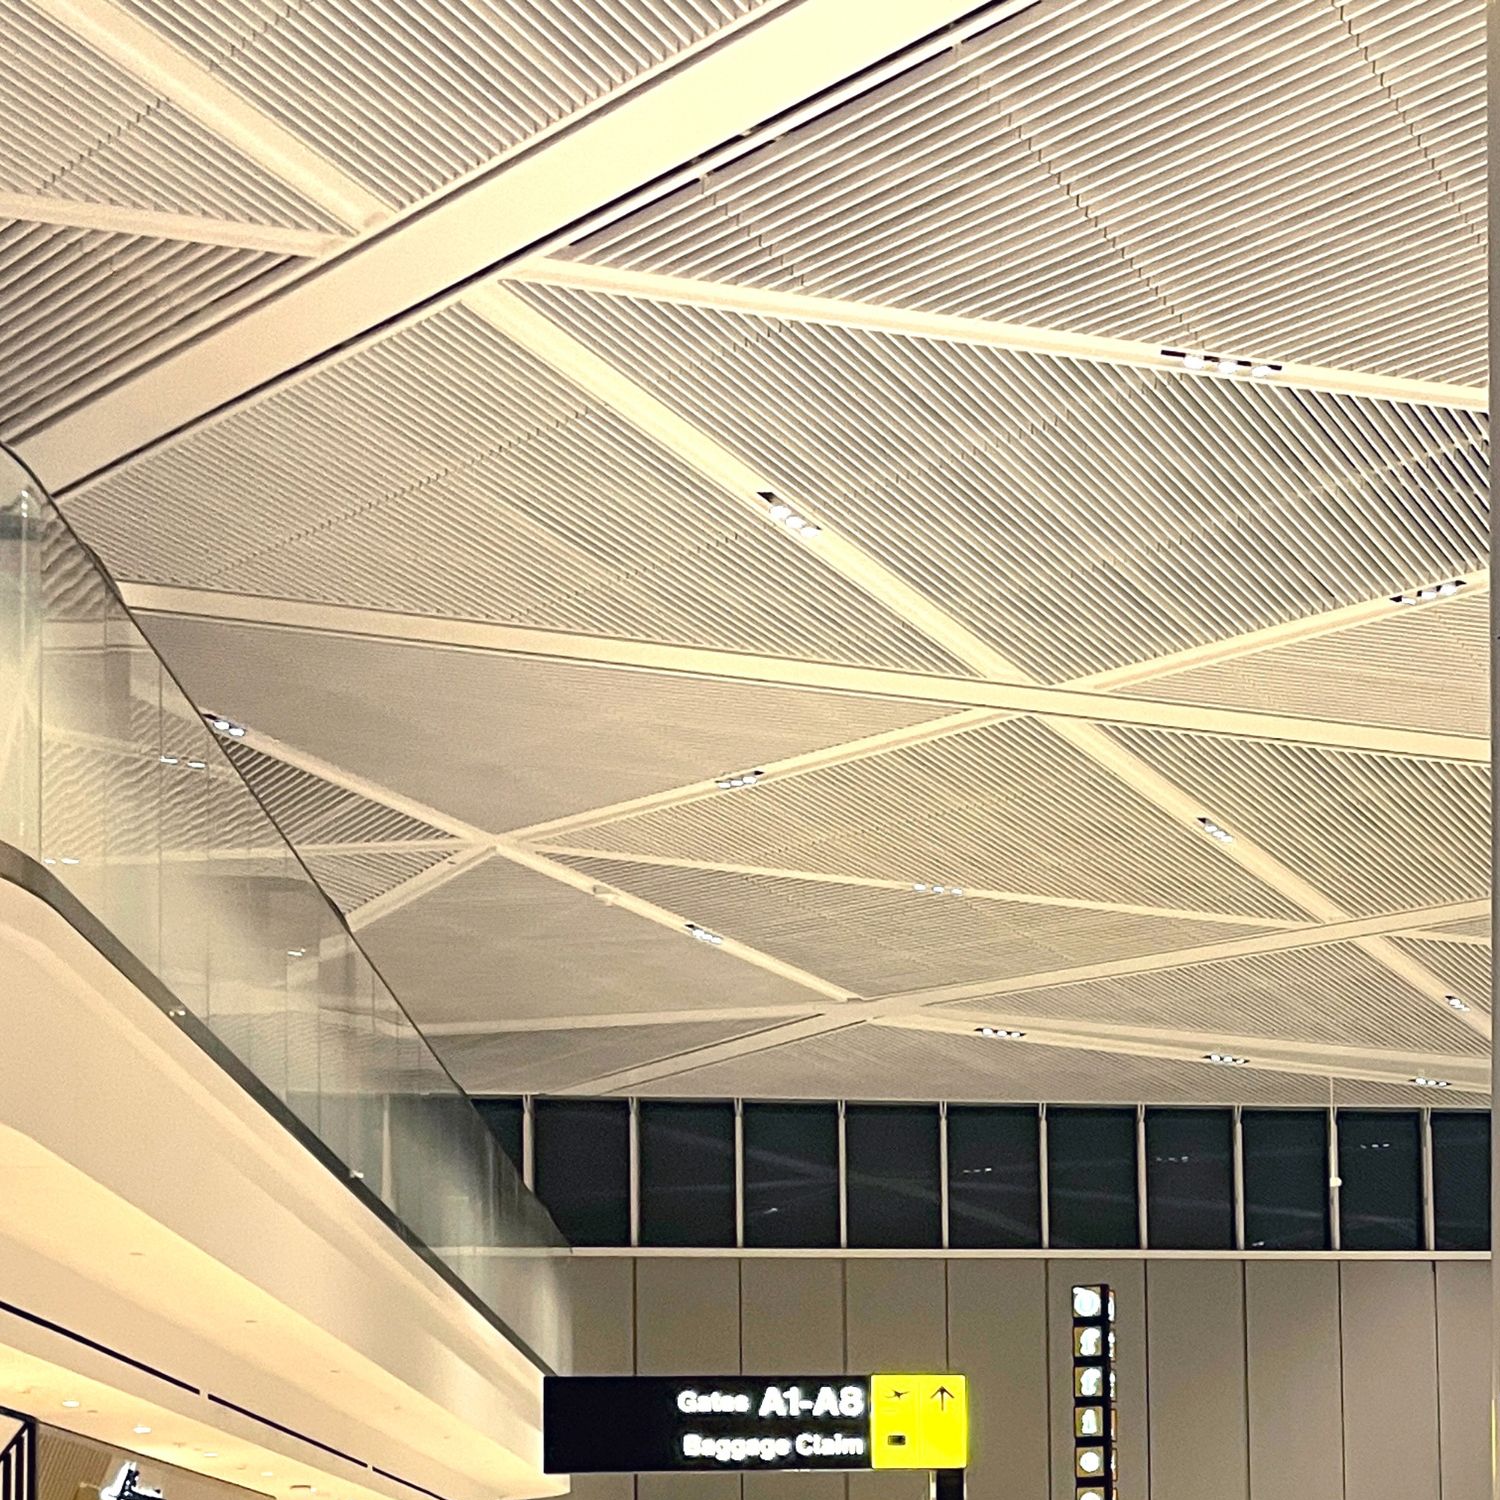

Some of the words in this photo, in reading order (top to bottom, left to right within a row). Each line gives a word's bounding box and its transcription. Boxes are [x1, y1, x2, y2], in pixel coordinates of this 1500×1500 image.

[758, 1386, 865, 1417] A1-A8
[683, 1433, 791, 1461] Baggage
[795, 1432, 864, 1456] Claim
